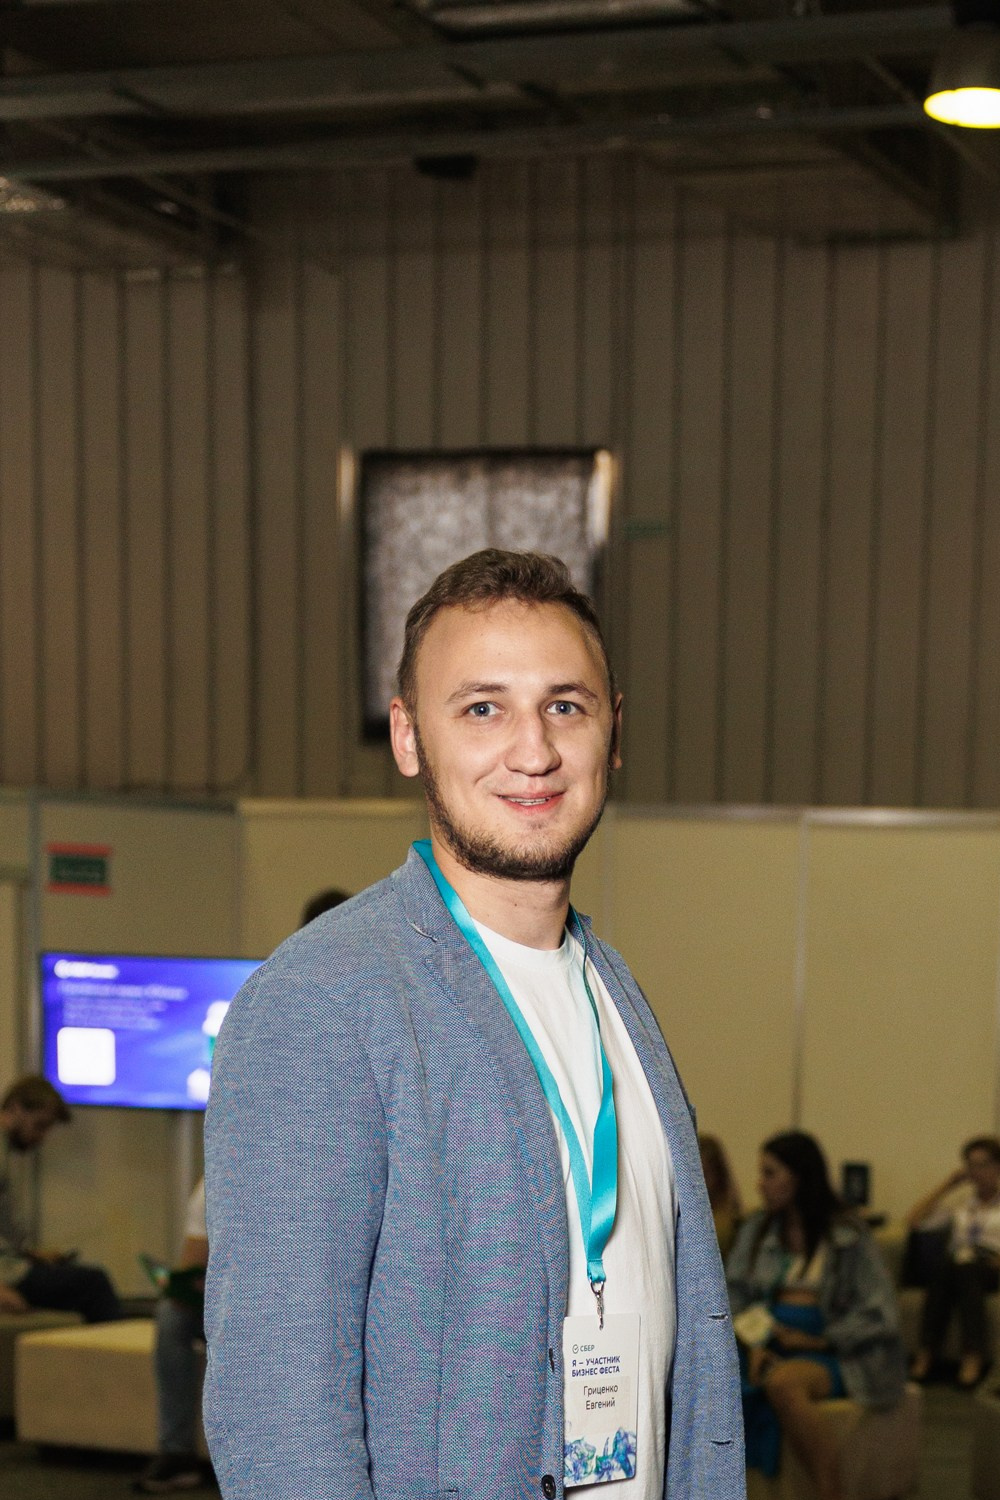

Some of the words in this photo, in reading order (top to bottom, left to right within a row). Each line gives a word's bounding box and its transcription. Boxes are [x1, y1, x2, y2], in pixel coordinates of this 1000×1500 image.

[580, 1344, 595, 1352] СБЕР
[572, 1359, 577, 1367] Я
[586, 1355, 621, 1366] УЧАСТНИК
[572, 1367, 598, 1377] БИЗНЕС
[599, 1365, 620, 1375] ФЕСТА
[583, 1385, 619, 1396] Гриценко
[585, 1397, 616, 1410] Евгений
